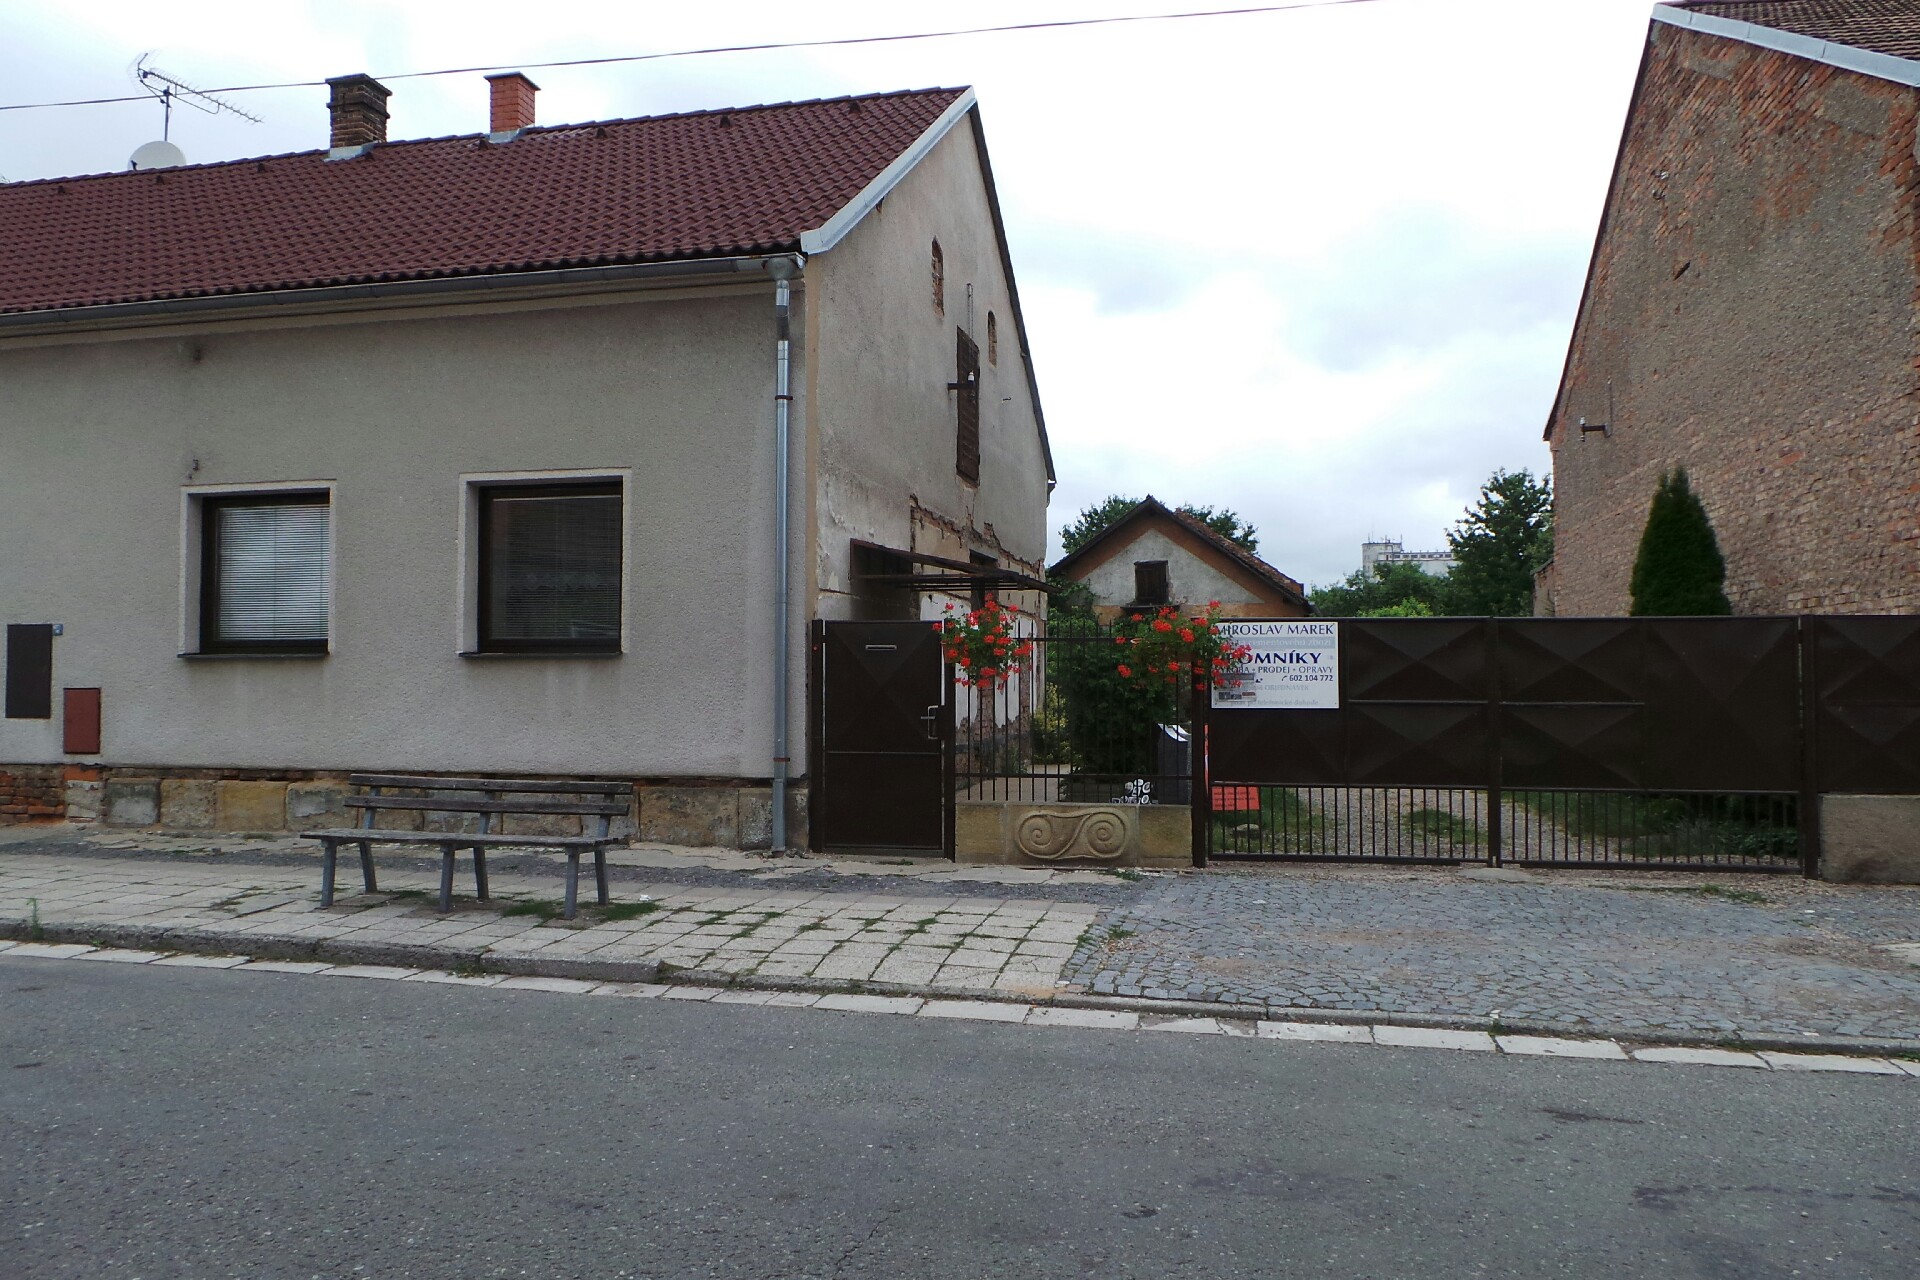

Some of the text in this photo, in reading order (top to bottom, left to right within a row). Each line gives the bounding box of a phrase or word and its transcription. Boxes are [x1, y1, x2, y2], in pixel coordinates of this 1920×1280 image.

[1287, 624, 1334, 635] MAREK
[1258, 666, 1290, 674] PRODEJ
[1298, 666, 1334, 674] OPRAVY
[1289, 674, 1334, 682] 602 104 772
